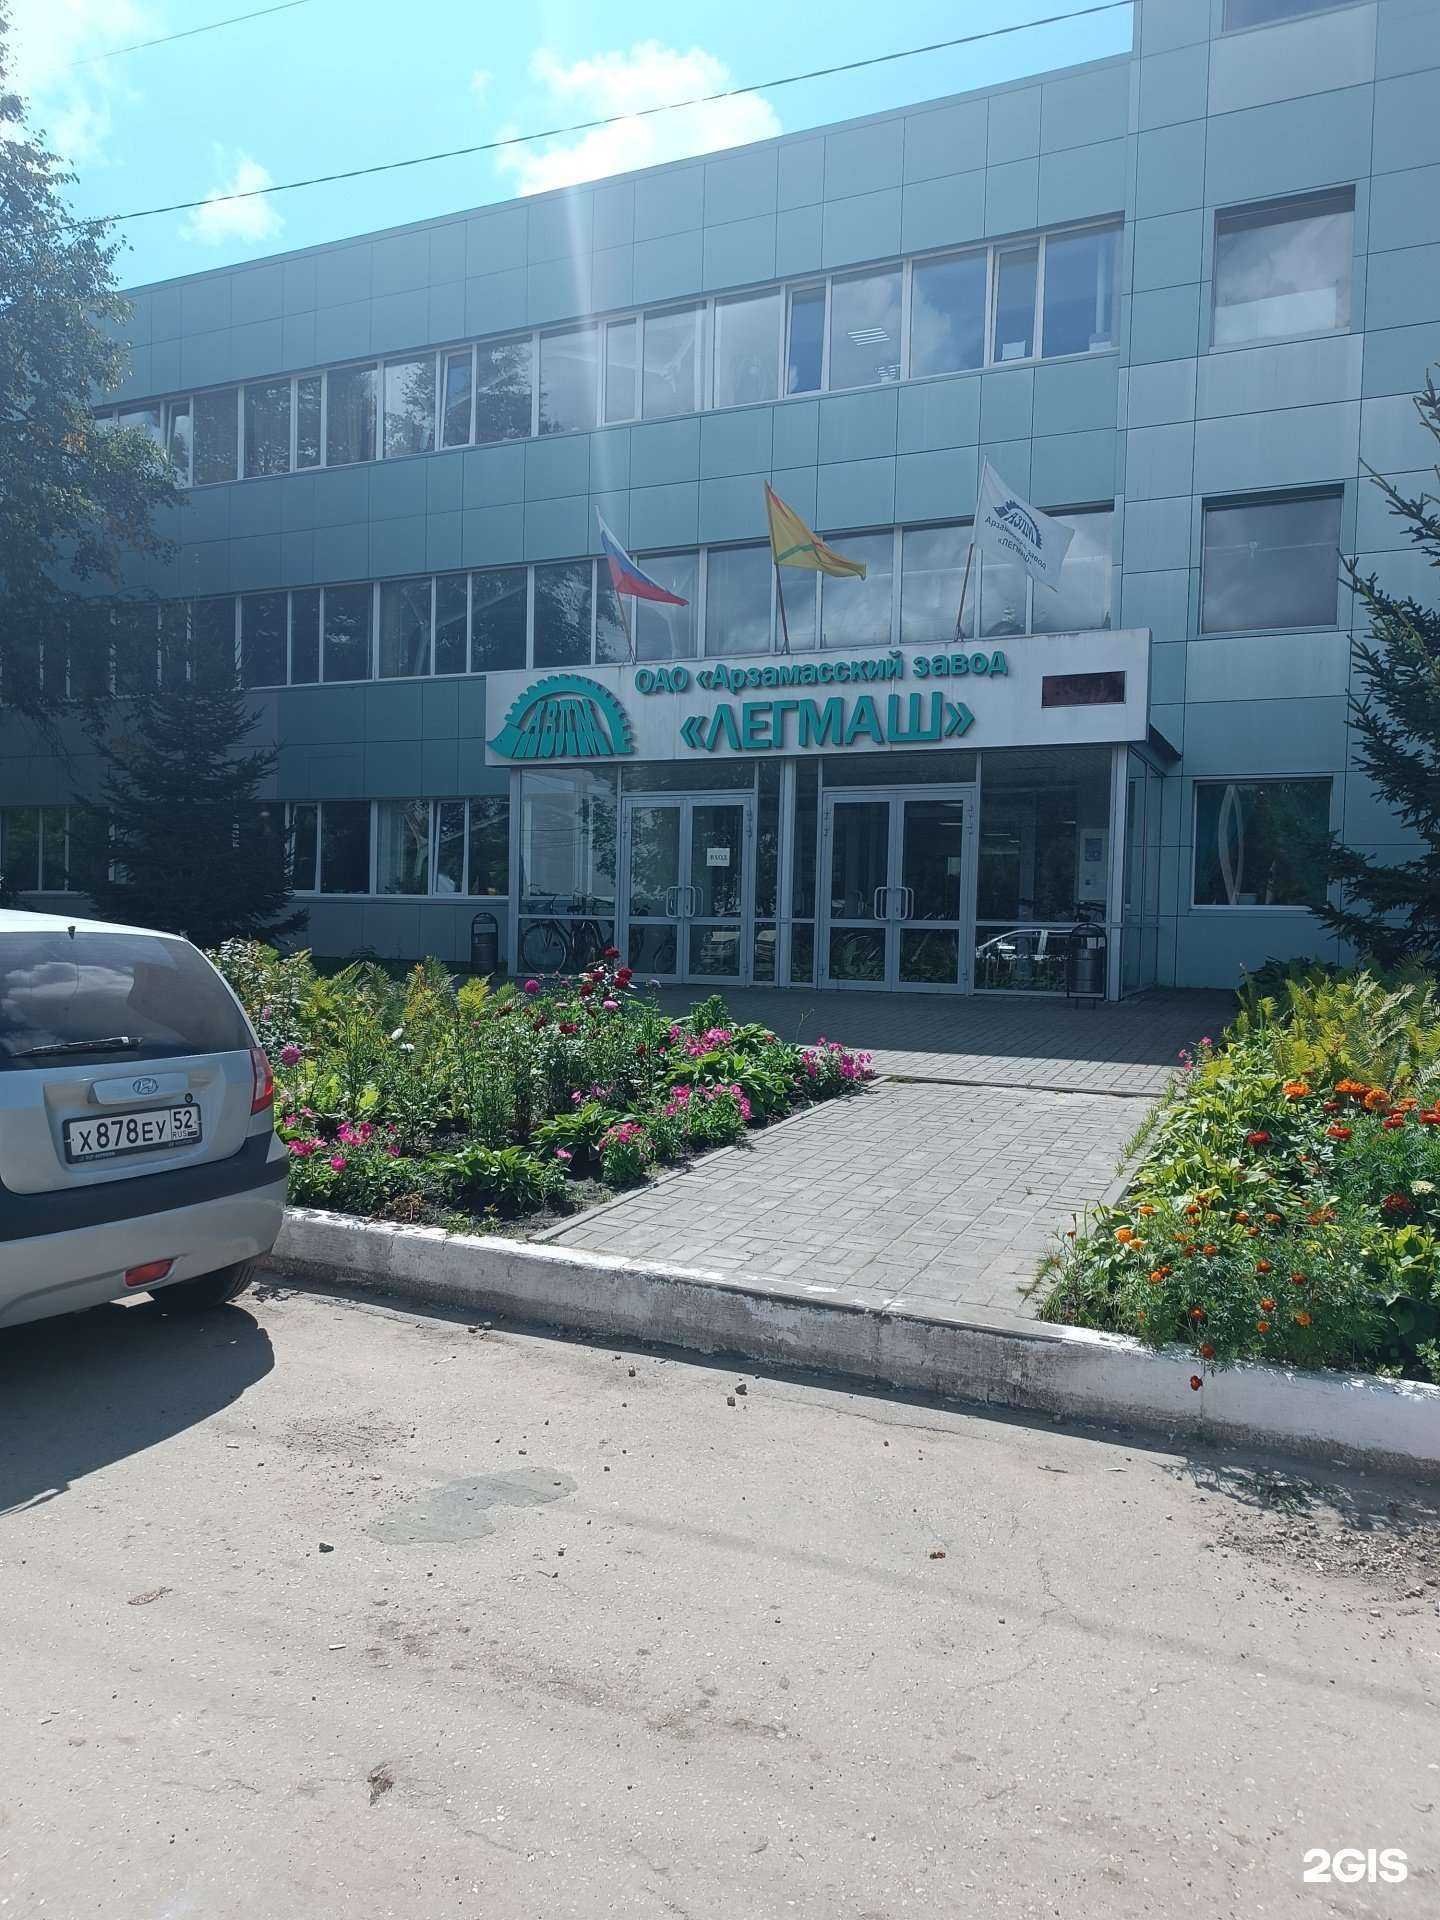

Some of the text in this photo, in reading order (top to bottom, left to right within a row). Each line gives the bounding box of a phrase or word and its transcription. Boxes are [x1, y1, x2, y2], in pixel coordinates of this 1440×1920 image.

[635, 650, 1009, 695] ОАО «Арзамасский завод
[680, 691, 976, 751] «ЛЕГМАШ»
[173, 1110, 193, 1130] 52
